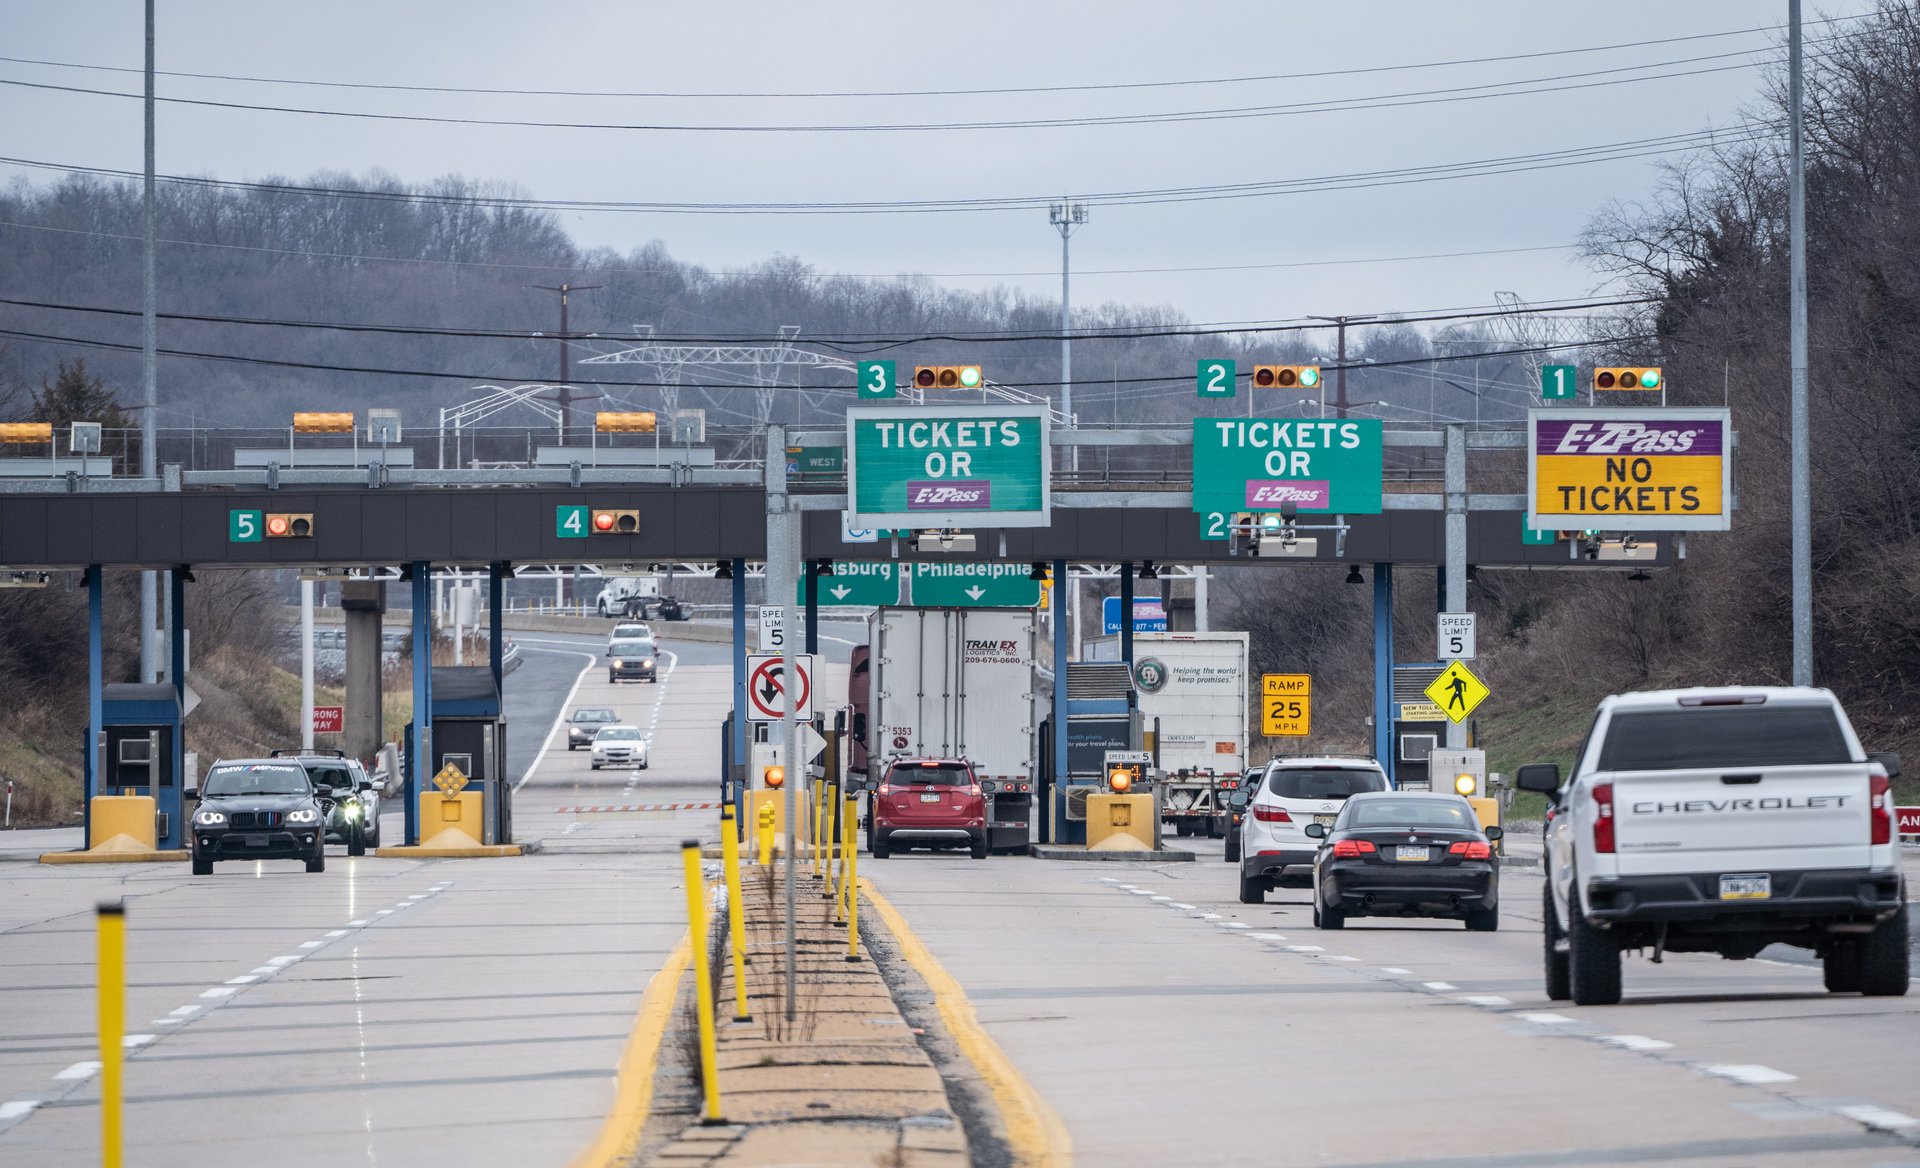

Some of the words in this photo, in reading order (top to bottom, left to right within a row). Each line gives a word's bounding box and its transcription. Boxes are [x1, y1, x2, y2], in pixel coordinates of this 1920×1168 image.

[868, 365, 886, 393] 3
[1207, 364, 1226, 392] 2
[1554, 369, 1564, 395] 1
[875, 420, 1020, 447] TICKETS
[1216, 422, 1360, 449] TICKETS
[1555, 423, 1698, 453] E-ZPass
[809, 458, 835, 466] WEST
[925, 452, 972, 478] OR
[1265, 450, 1311, 476] OR
[1606, 458, 1652, 482] NO
[914, 487, 981, 503] E-ZPass
[1252, 487, 1319, 501] E-ZPass
[1558, 486, 1700, 511] TICKETS
[238, 514, 254, 538] 5
[564, 510, 581, 534] 4
[1207, 512, 1224, 536] 2
[799, 561, 891, 580] isburg
[762, 610, 785, 618] SPEE
[1442, 618, 1472, 626] SPEED
[771, 629, 784, 646] 5
[966, 640, 998, 649] TRAN
[1000, 640, 1018, 649] EX
[1450, 637, 1463, 653] 5
[1173, 667, 1200, 675] Helping
[1177, 676, 1194, 684] keep
[1269, 681, 1304, 690] RAMP
[314, 711, 338, 719] RONG
[1271, 701, 1301, 719] 25
[893, 727, 911, 736] 5353
[1275, 723, 1297, 731] MPH
[217, 766, 244, 774] BMW
[1633, 795, 1852, 814] CHEVROLET
